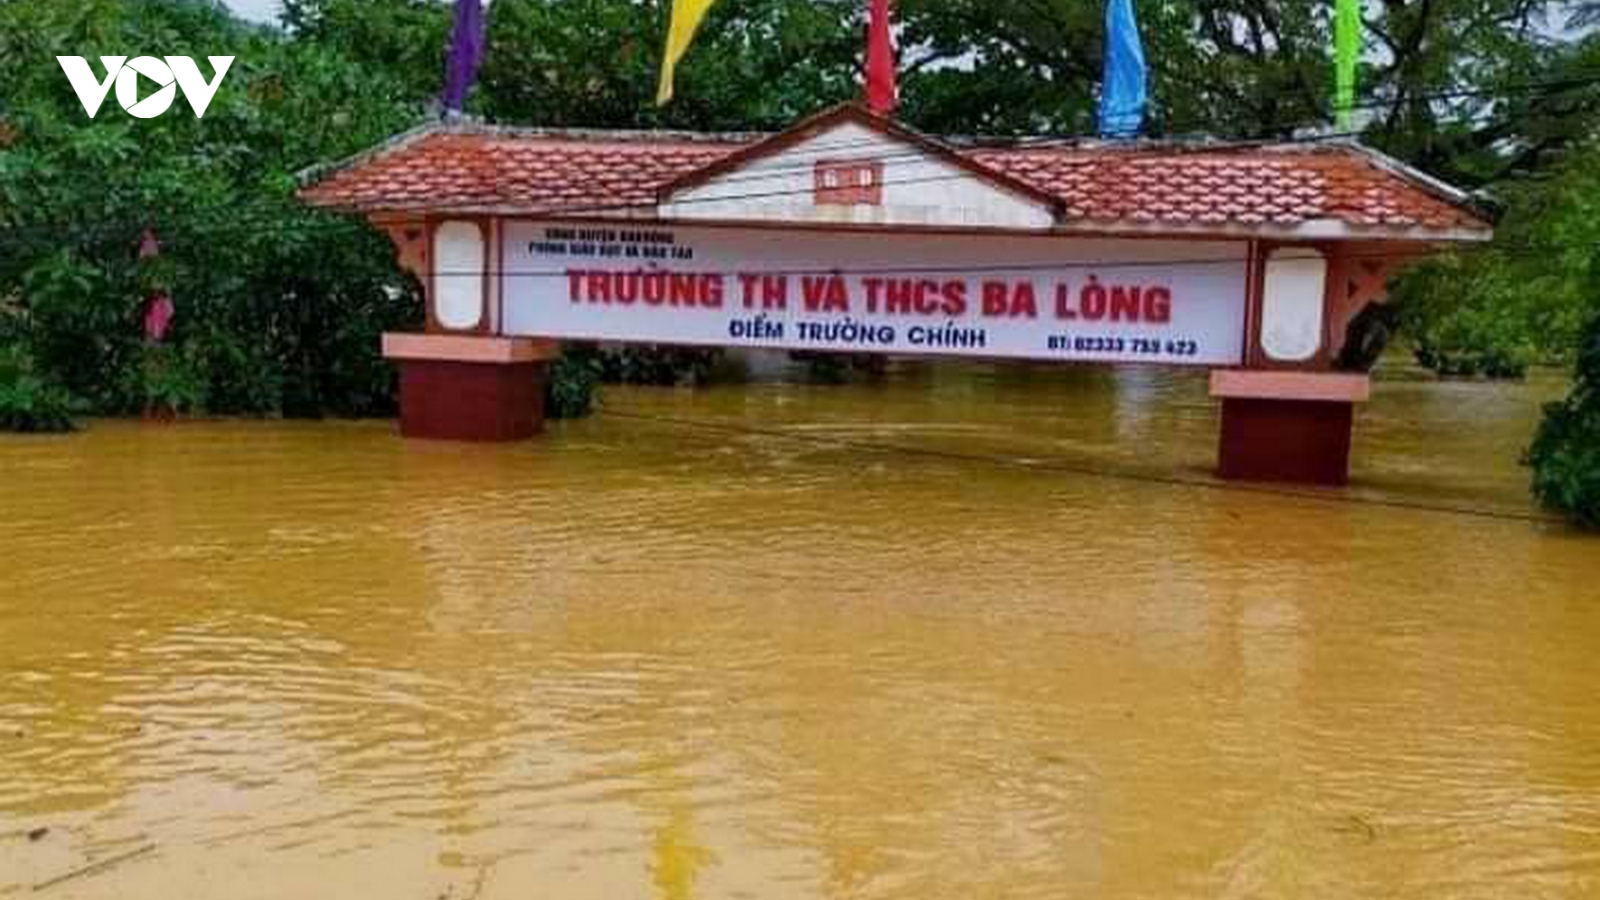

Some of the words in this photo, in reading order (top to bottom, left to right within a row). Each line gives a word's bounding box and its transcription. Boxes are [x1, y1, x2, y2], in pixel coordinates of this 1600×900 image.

[566, 262, 723, 308] TRƯỜNG
[738, 272, 787, 311] TH
[802, 268, 851, 313] VÀ
[862, 276, 967, 317] THCS
[981, 280, 1037, 318] BA
[1055, 273, 1172, 323] LÒNG
[729, 313, 784, 339] ĐIỂM
[797, 317, 895, 344] TRƯỜNG
[907, 321, 987, 348] CHÍNH
